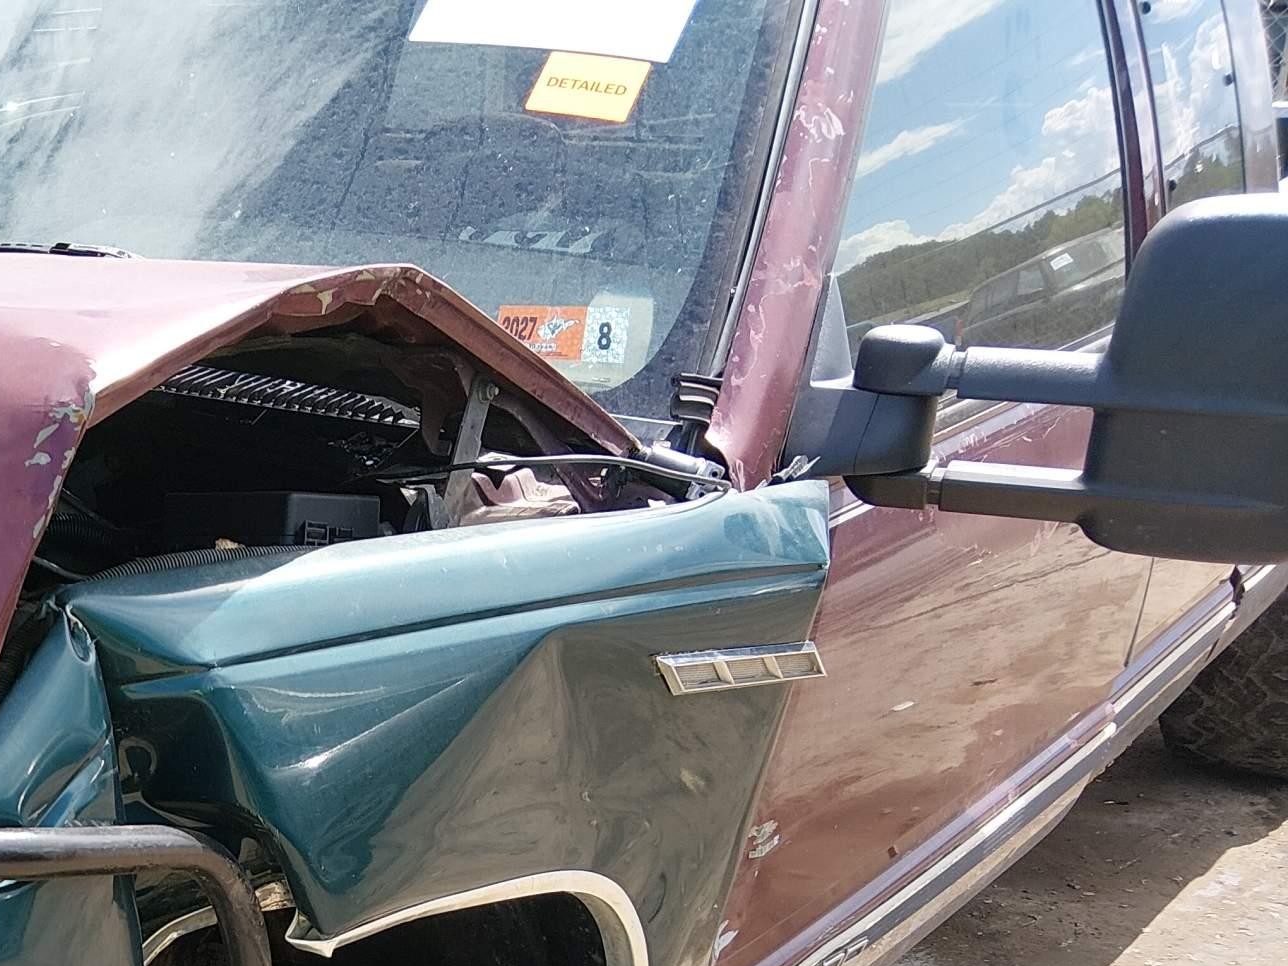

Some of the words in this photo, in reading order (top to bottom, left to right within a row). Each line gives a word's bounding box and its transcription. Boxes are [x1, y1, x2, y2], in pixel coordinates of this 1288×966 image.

[546, 76, 628, 97] DETAILED
[502, 316, 538, 341] 2027
[597, 321, 612, 351] 8
